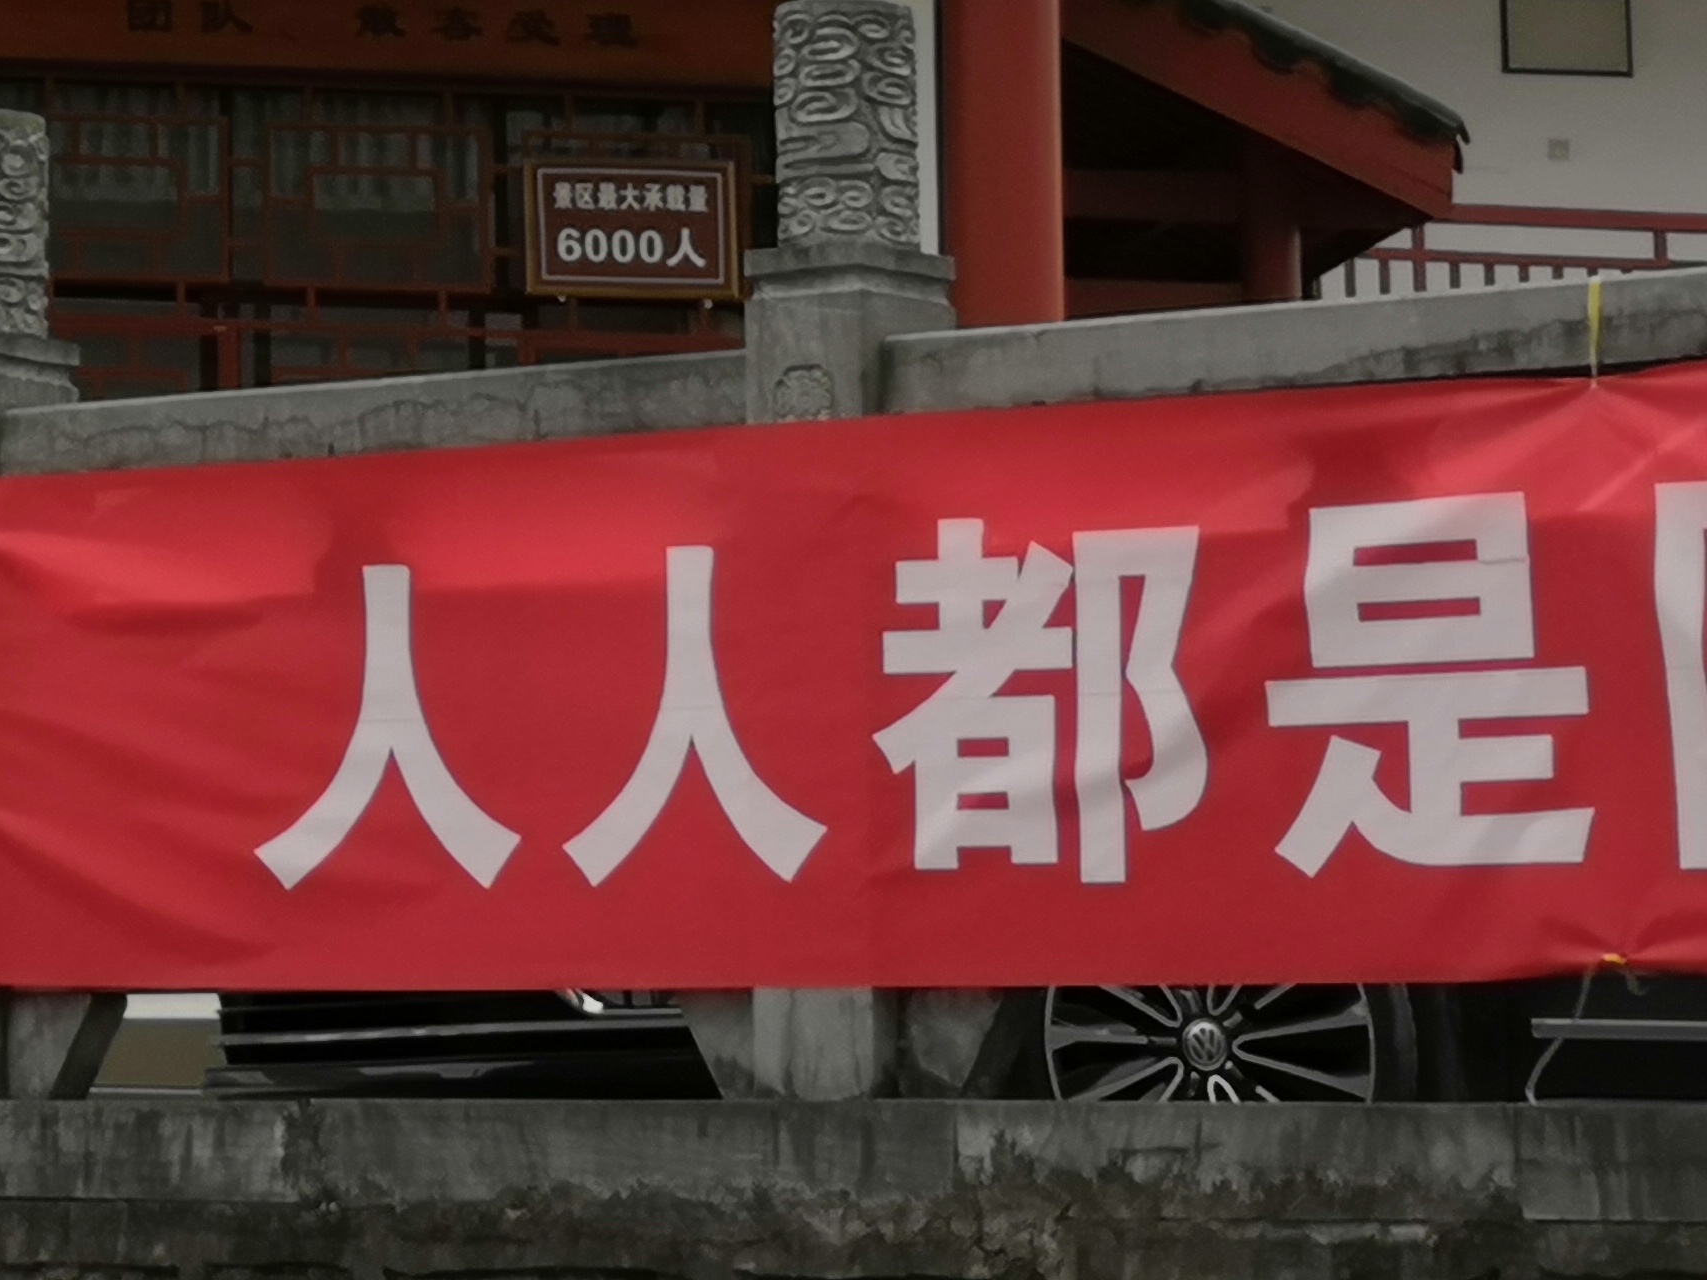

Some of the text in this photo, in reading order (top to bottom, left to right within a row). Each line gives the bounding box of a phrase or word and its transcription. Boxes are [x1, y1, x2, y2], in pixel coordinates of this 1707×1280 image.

[557, 226, 708, 269] 6000人
[253, 480, 1707, 889] 人人都是
